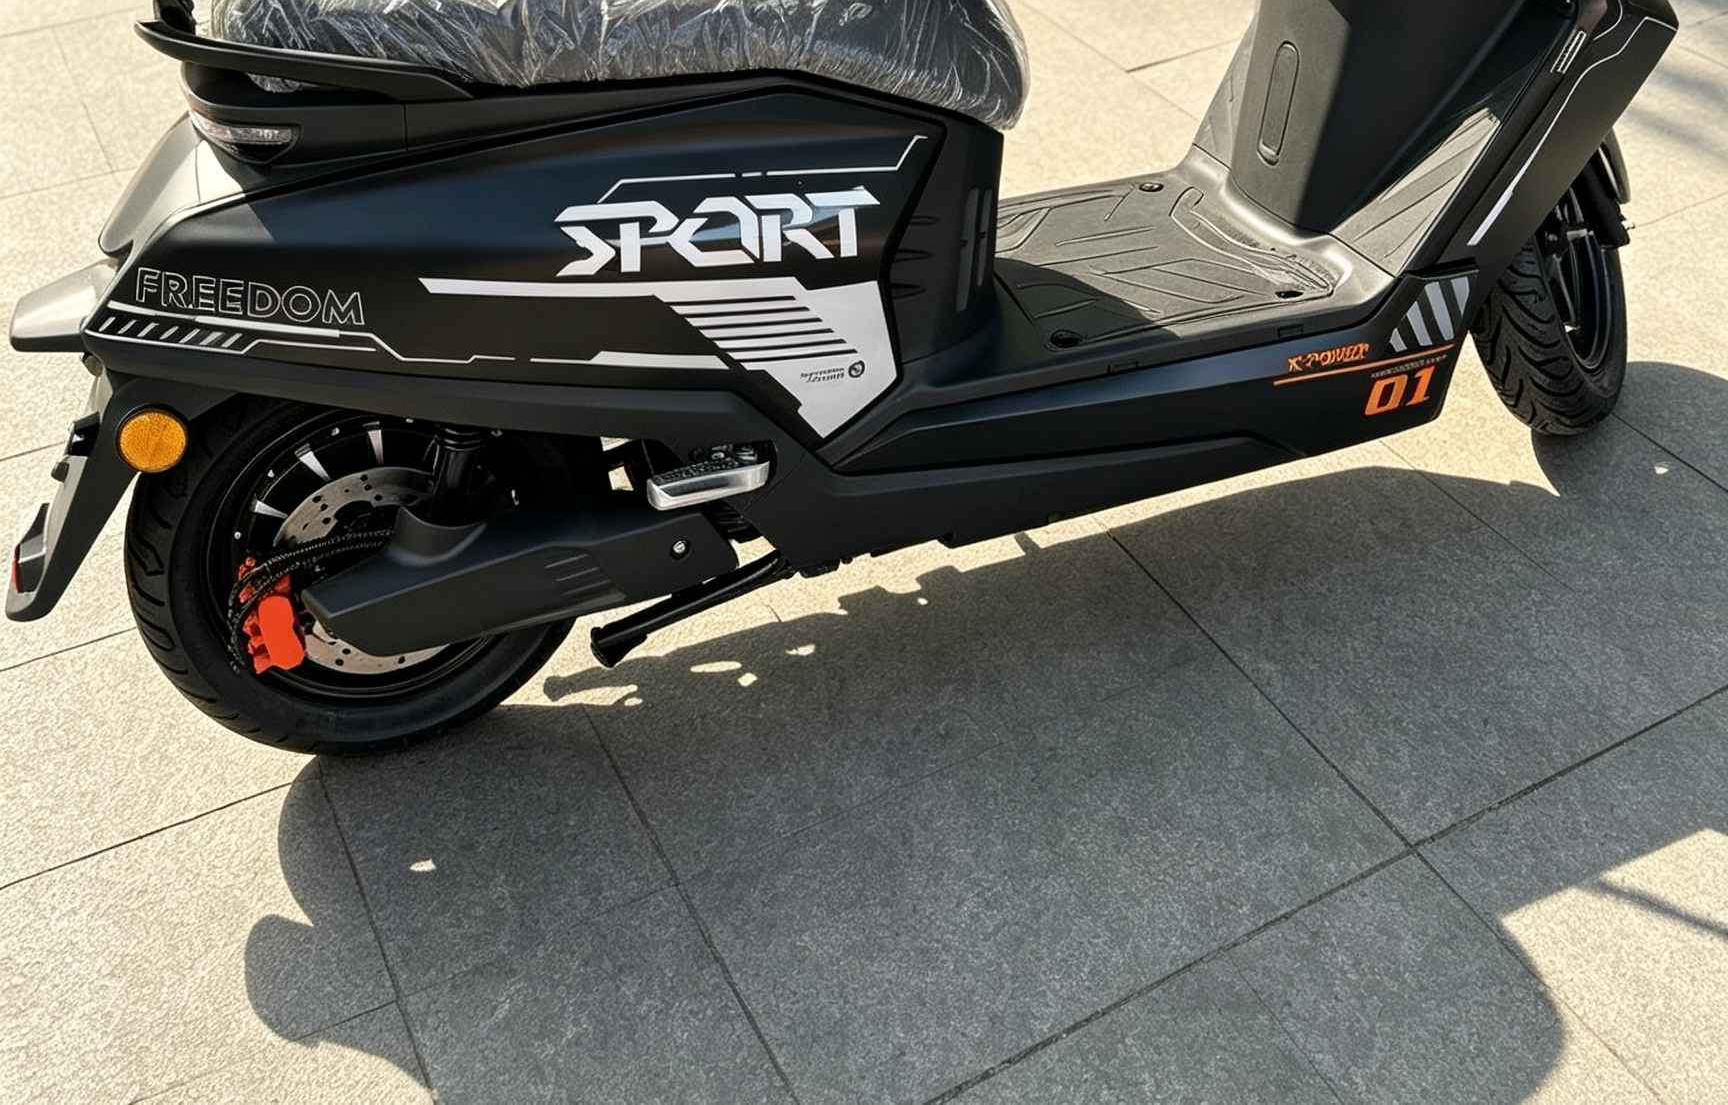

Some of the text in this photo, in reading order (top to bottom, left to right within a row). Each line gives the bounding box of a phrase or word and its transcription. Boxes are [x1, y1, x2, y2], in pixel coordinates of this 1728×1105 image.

[554, 186, 881, 277] SPORT
[135, 266, 365, 325] FREEDOM
[1364, 365, 1436, 415] 01
